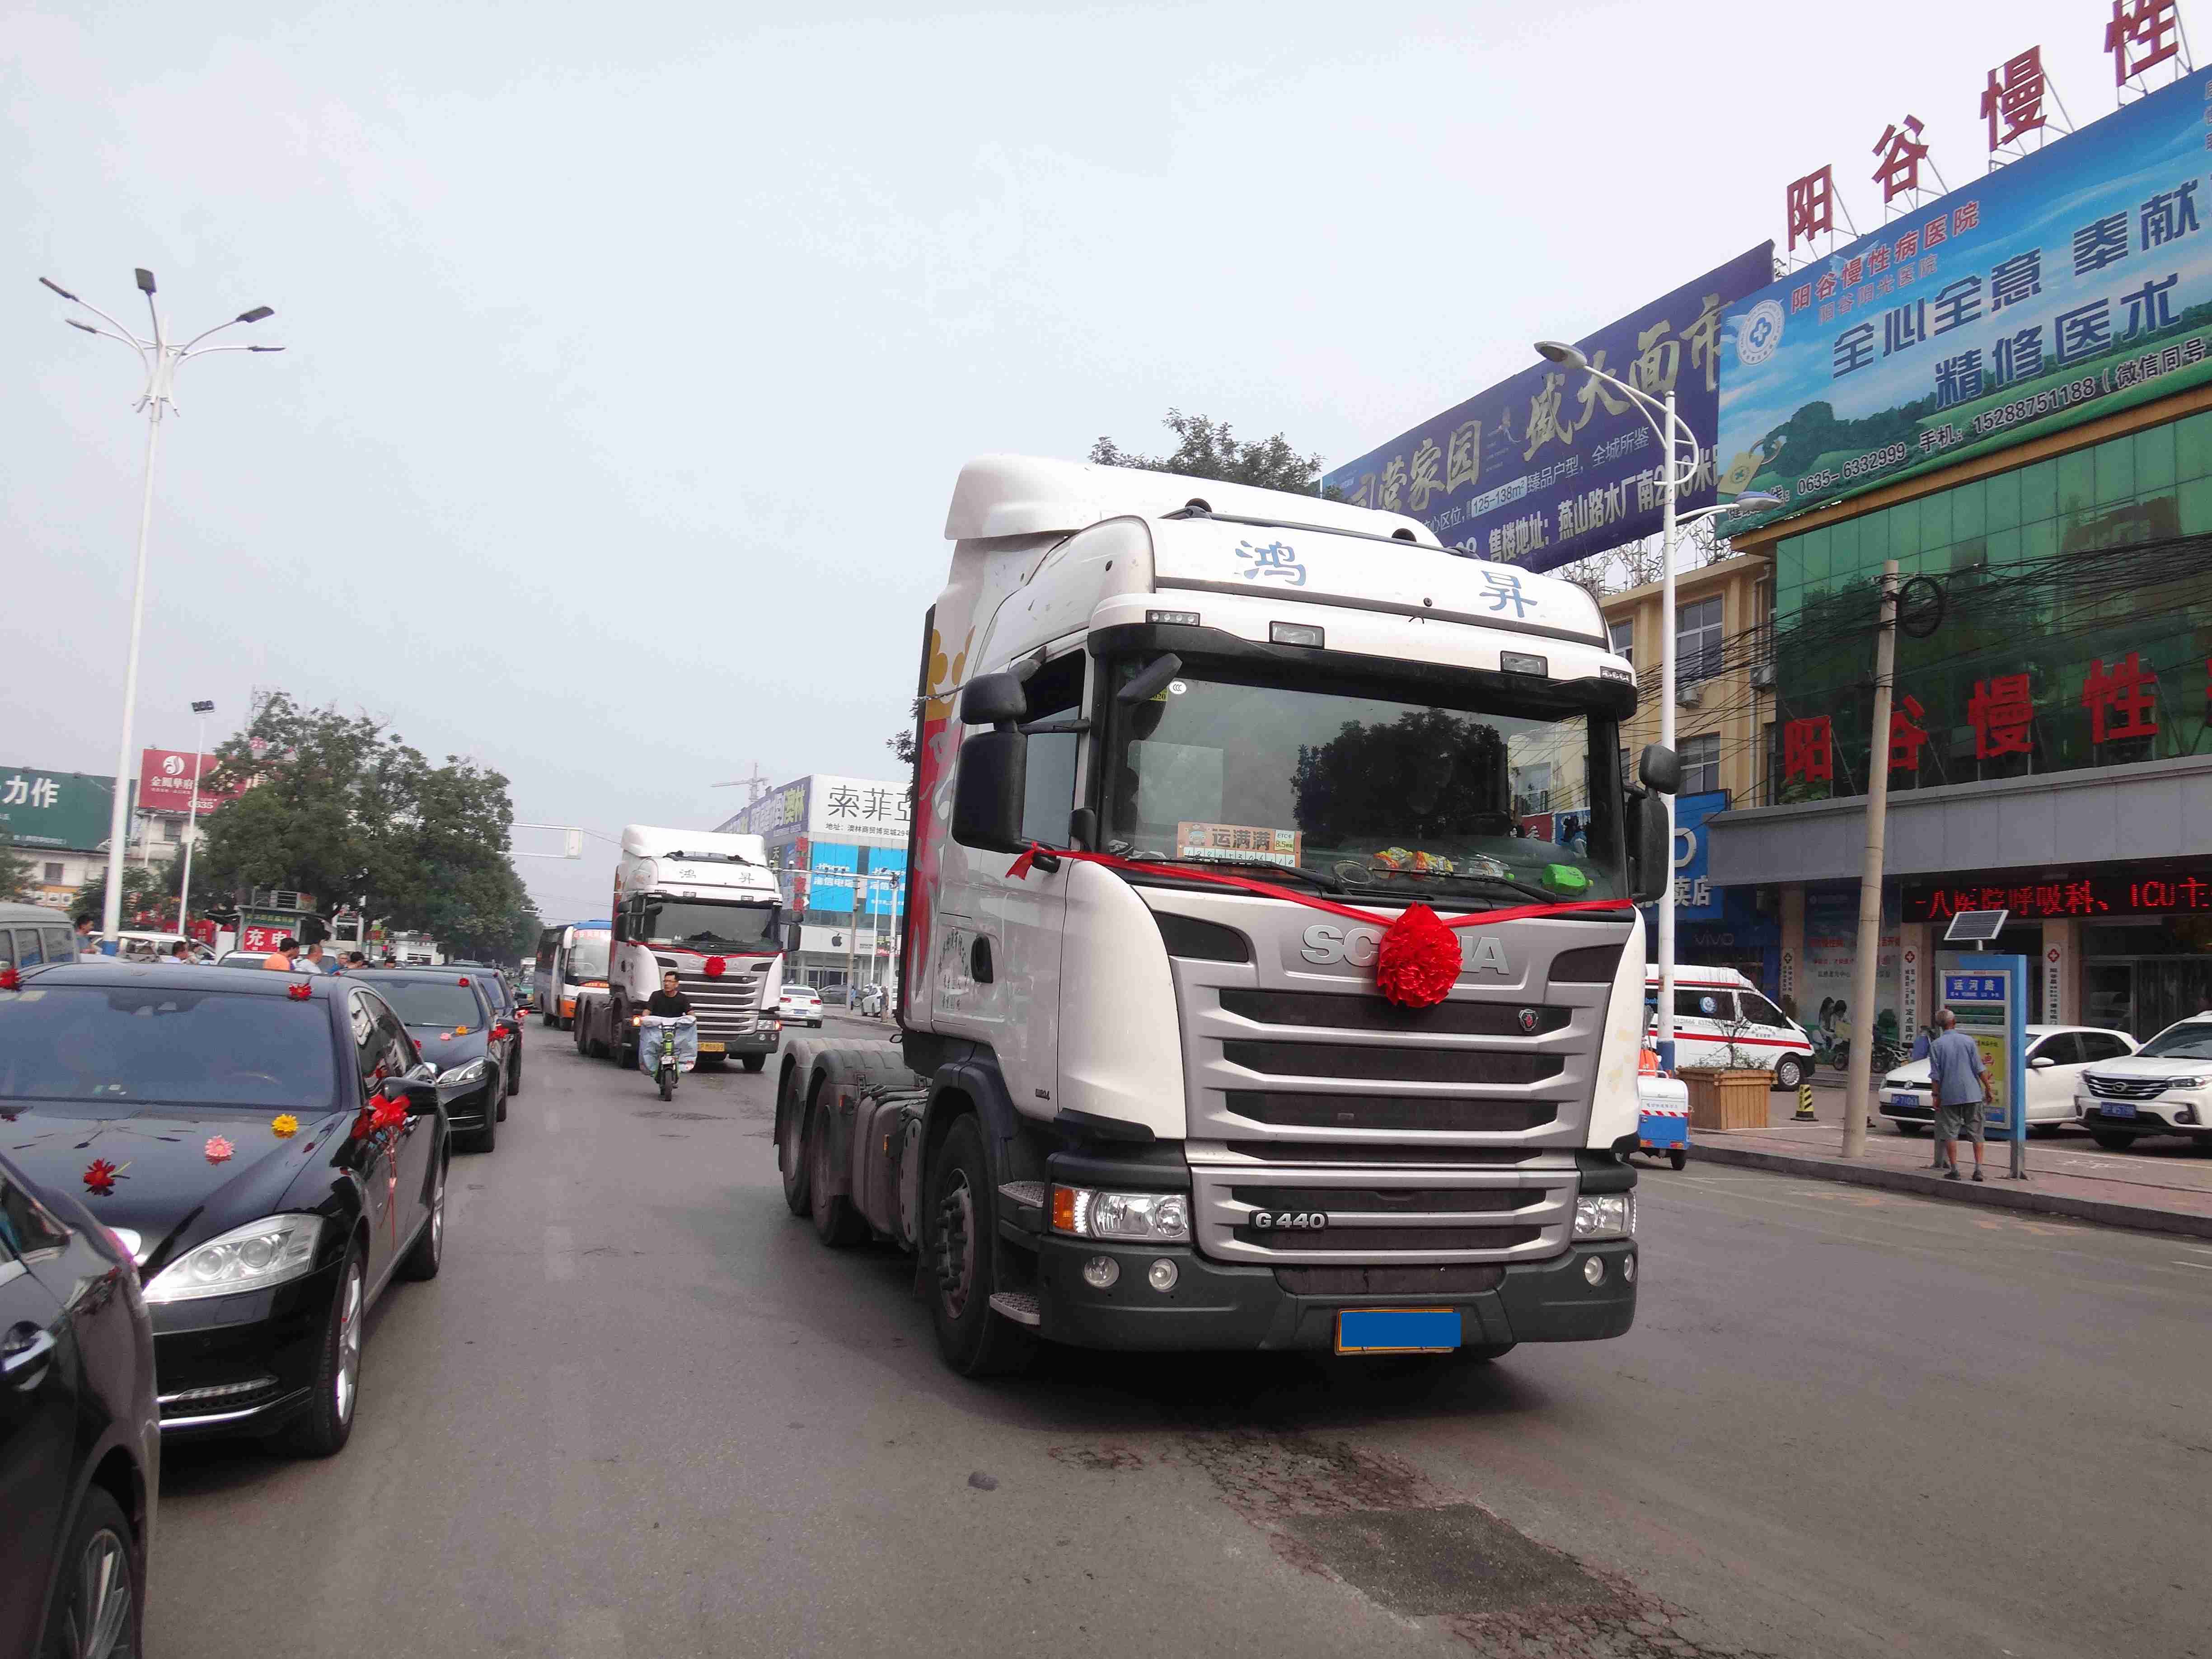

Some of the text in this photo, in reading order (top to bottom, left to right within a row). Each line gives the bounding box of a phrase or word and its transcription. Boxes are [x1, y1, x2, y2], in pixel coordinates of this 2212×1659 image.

[1787, 0, 2179, 253] 阳谷慢性
[1790, 200, 1980, 315] 阳谷慢性病医院
[1832, 248, 2043, 380] 全心全意
[2073, 179, 2201, 276] 奉献
[1935, 272, 2182, 407] 精修医术
[1973, 376, 2096, 435] 15288751188
[1420, 504, 1467, 535] 心区位，
[1235, 539, 1538, 618] 鸿 昇
[1784, 651, 2212, 784] 阳谷慢性
[1, 774, 60, 808] 力作
[1212, 828, 1270, 850] 运满满
[1301, 924, 1510, 975] SCIA
[1256, 1213, 1325, 1229] G 440
